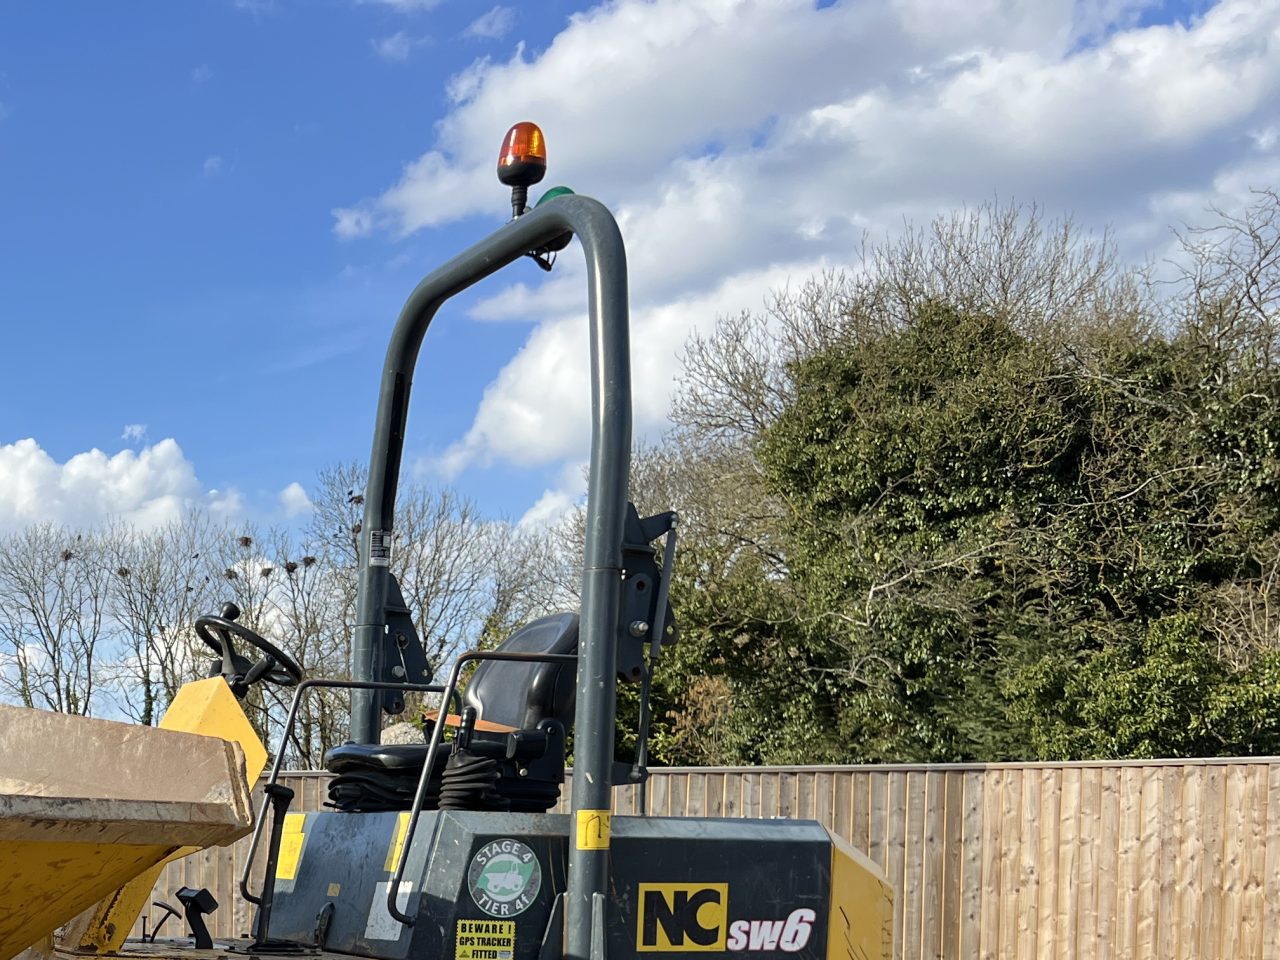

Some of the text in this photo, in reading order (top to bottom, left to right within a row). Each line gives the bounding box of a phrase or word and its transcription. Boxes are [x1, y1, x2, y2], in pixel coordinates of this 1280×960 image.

[476, 840, 533, 865] STAGE 4
[478, 893, 530, 915] TIER 4f
[642, 888, 721, 946] NC
[459, 937, 511, 947] GPS TRACKER
[472, 950, 497, 959] FITTED
